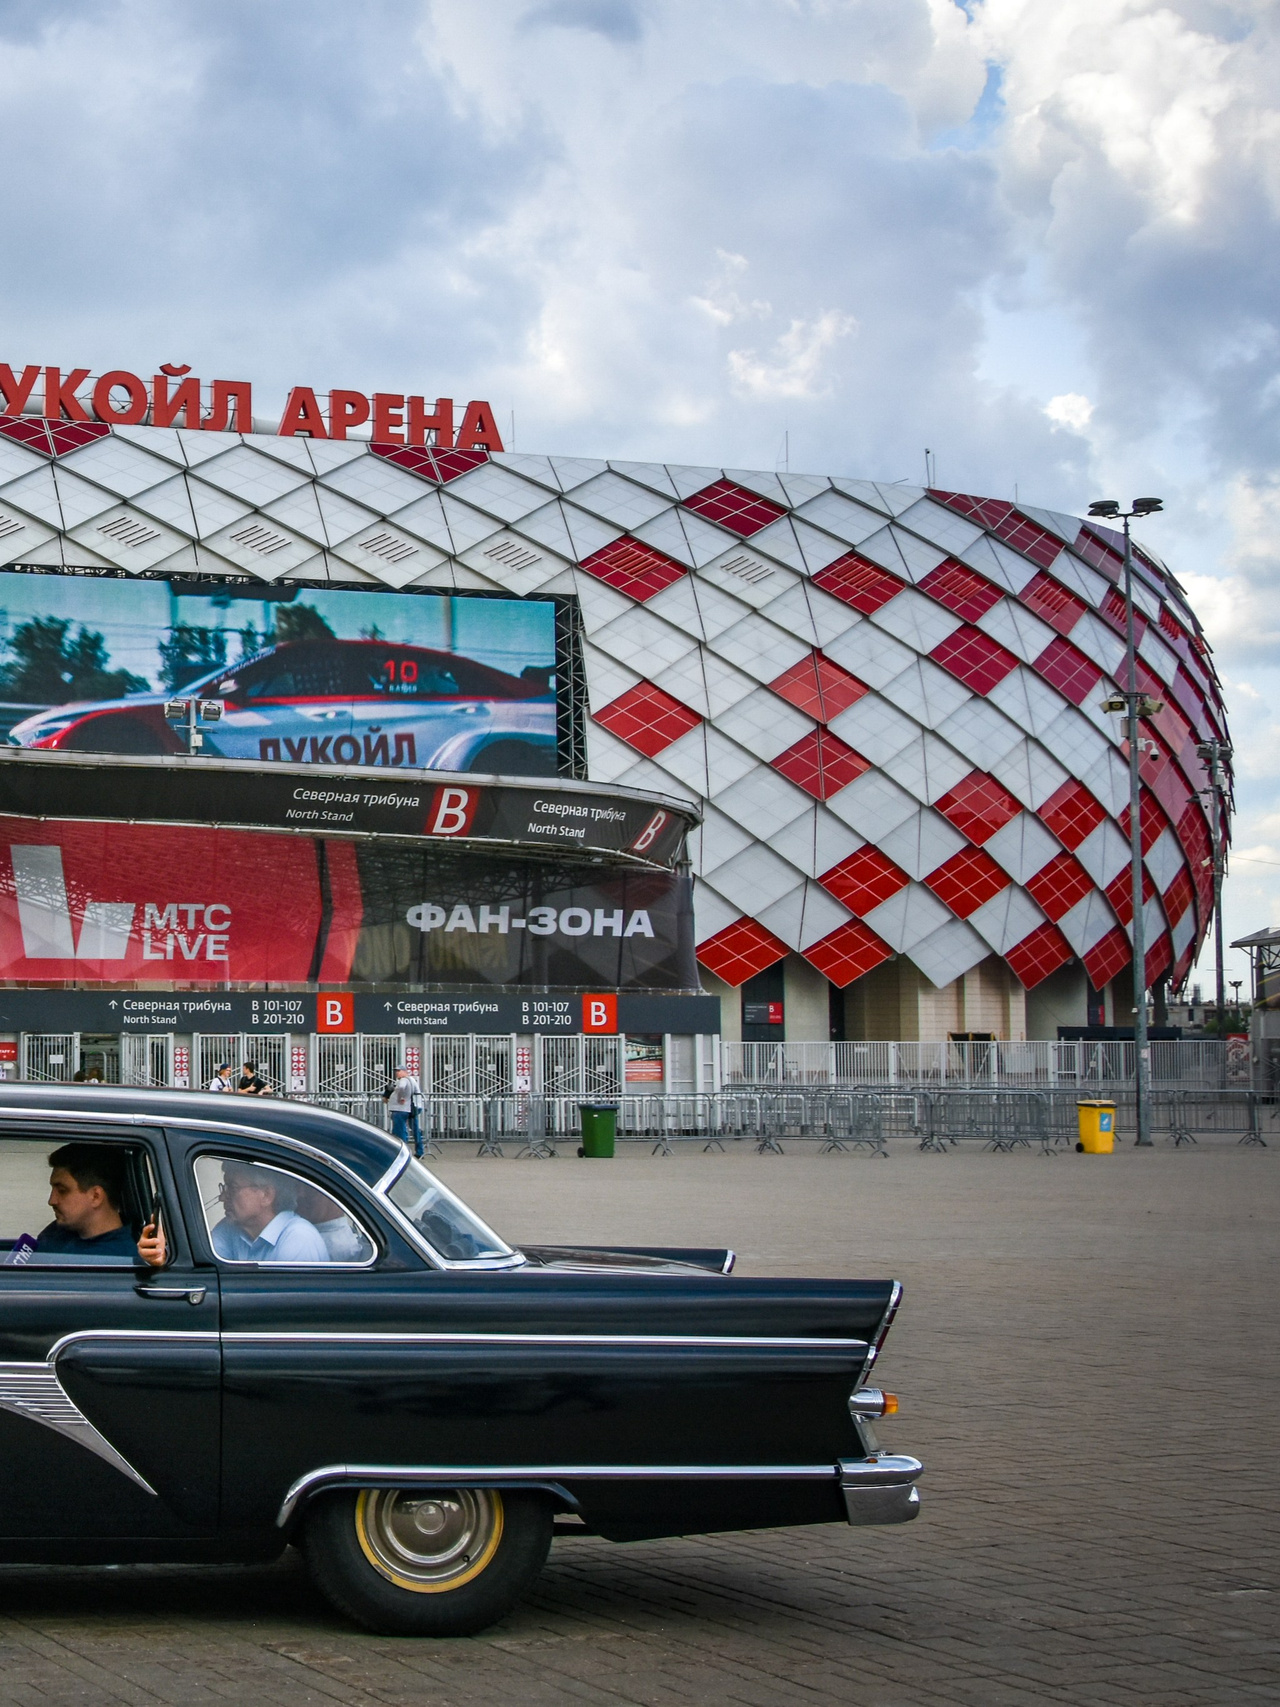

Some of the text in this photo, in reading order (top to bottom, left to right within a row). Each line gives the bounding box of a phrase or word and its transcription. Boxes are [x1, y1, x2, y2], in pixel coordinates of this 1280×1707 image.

[277, 386, 504, 451] АРЕНА
[383, 659, 418, 682] 10
[259, 726, 417, 765] ЛУКОЙЛ
[293, 788, 420, 808] Северная трибуна
[285, 809, 354, 822] North Stand
[533, 800, 627, 823] Северная трибуна
[527, 823, 586, 838] North Stand
[406, 902, 655, 938] ФАН-ЗОНА
[142, 933, 229, 961] LIVE
[123, 999, 231, 1014] Северная трибуна
[263, 1000, 302, 1011] 101-107
[397, 1001, 499, 1014] Северная трибуна
[533, 1002, 569, 1012] 101-107
[123, 1015, 177, 1024] North Stand
[263, 1014, 305, 1024] 201-210
[397, 1017, 448, 1025] North Stand
[533, 1015, 571, 1025] 201-210
